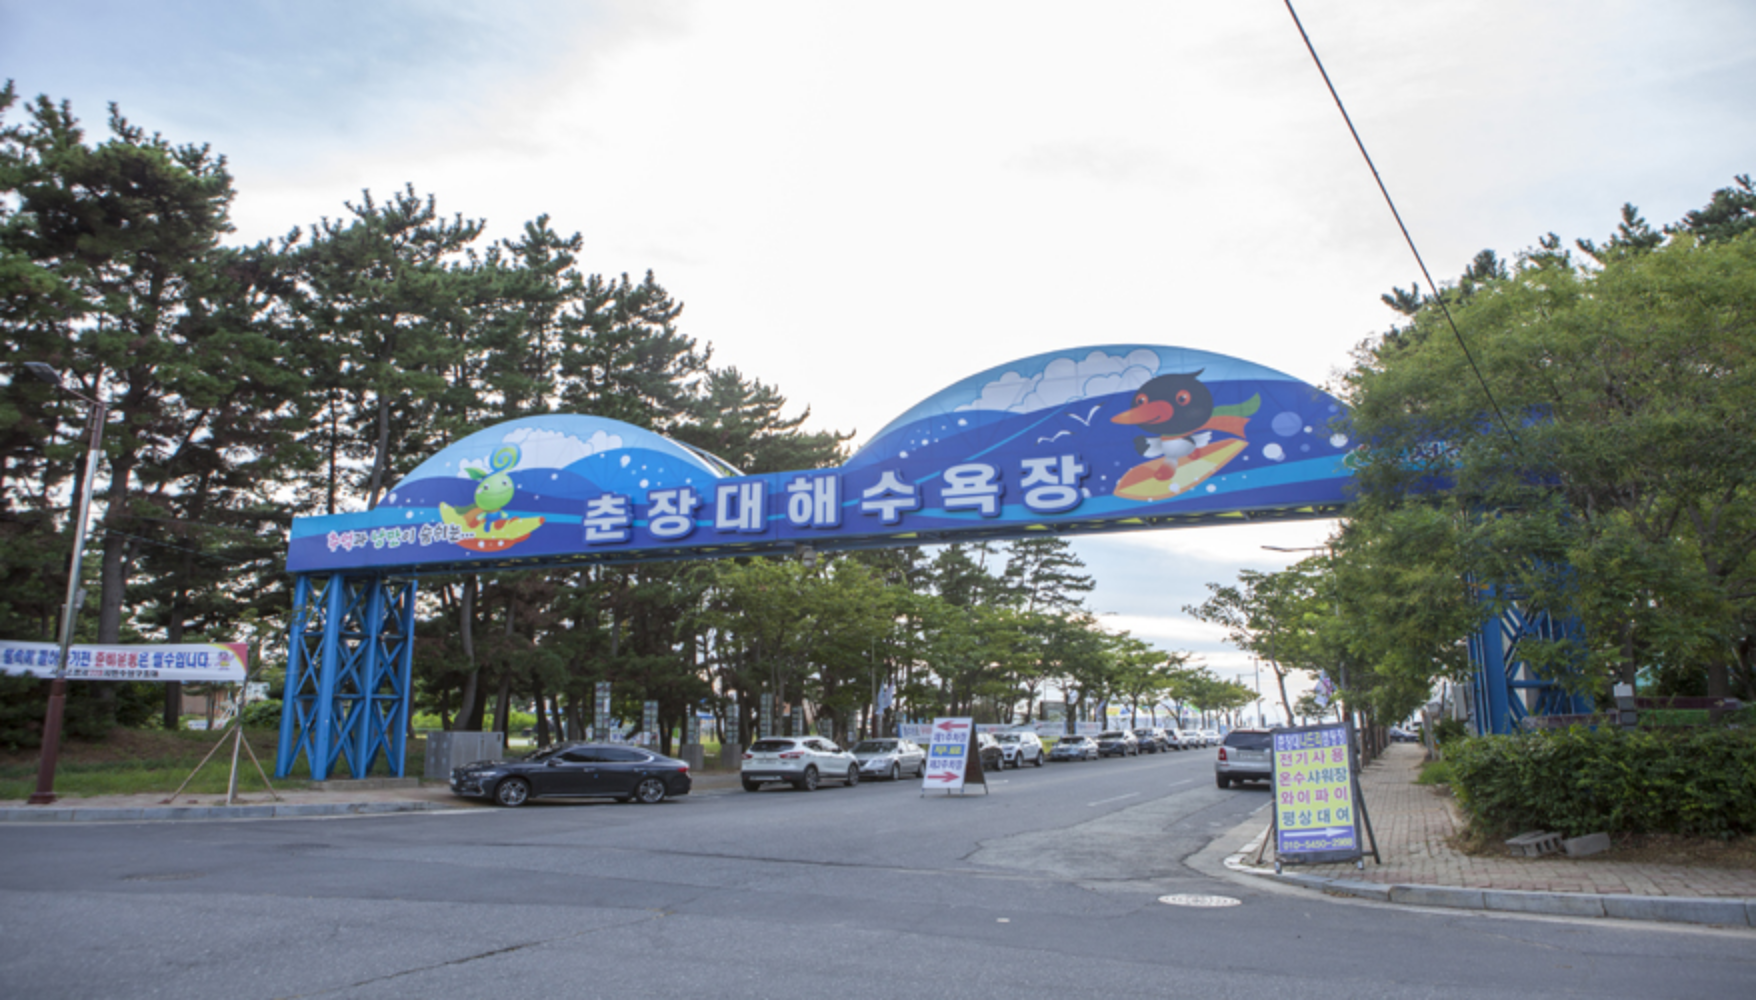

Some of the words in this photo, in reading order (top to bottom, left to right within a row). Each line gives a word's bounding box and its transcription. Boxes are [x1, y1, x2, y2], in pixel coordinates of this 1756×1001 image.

[582, 455, 1087, 542] 춘장대해수욕장
[327, 530, 368, 552] 추억과
[371, 526, 416, 549] 낭만이
